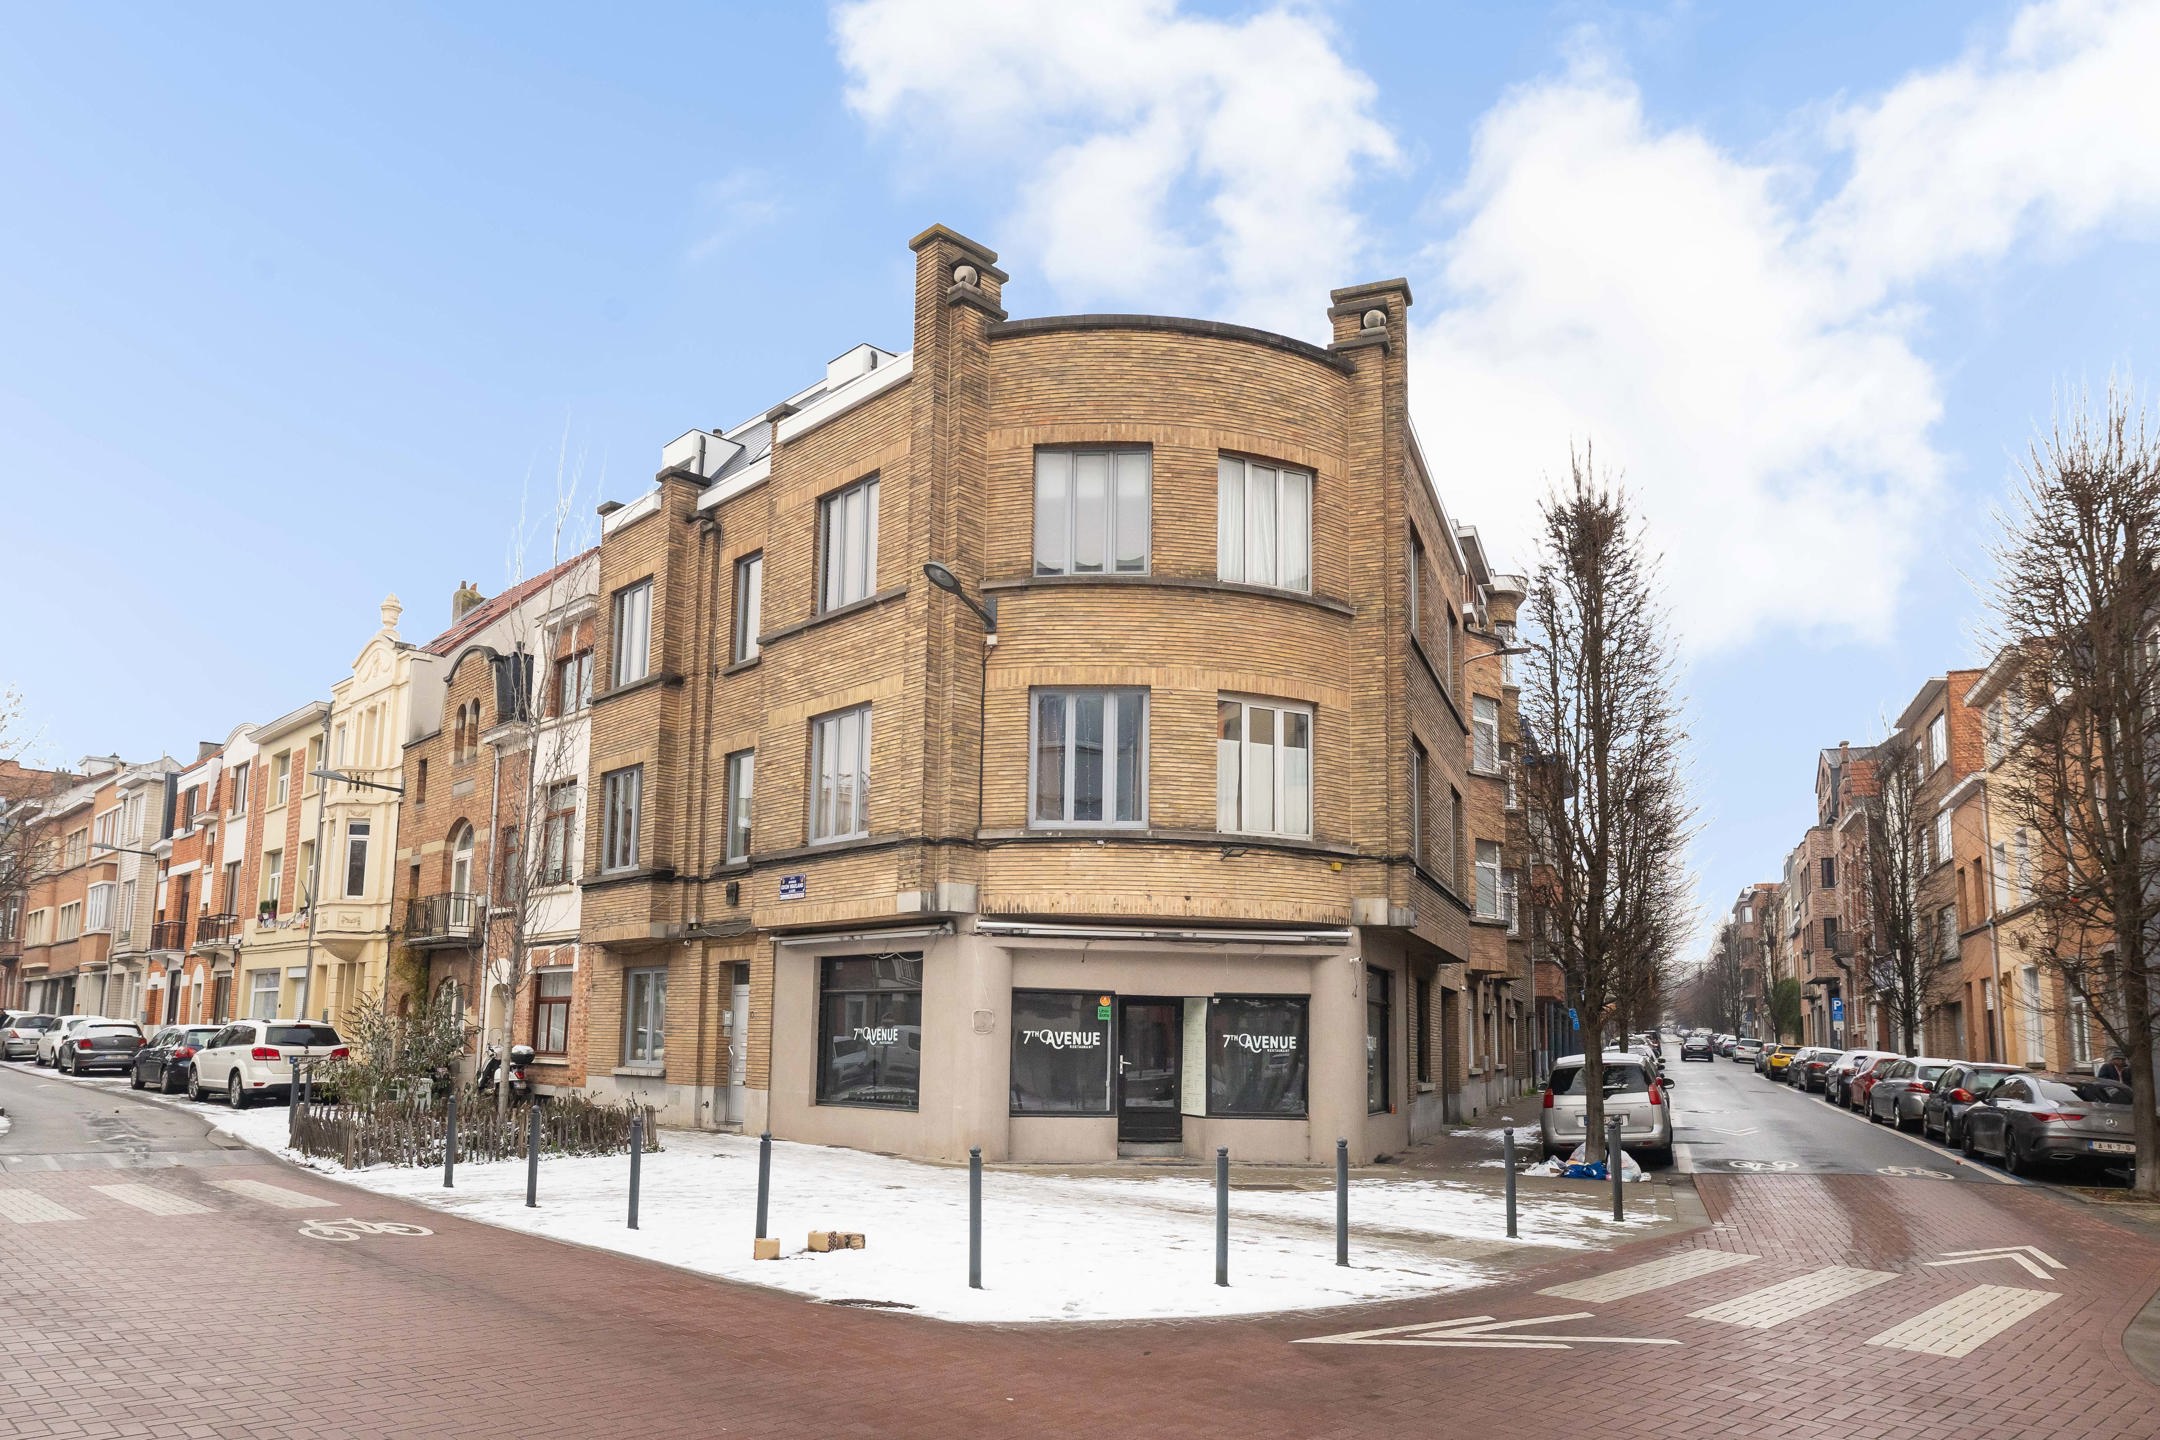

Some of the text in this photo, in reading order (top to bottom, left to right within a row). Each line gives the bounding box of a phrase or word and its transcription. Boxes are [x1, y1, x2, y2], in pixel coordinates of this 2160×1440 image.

[1834, 1001, 1841, 1010] P
[862, 1027, 898, 1045] AVENUE
[1023, 1029, 1100, 1049] 7TH AVENUE
[1222, 1033, 1297, 1053] 7TH AVENUE
